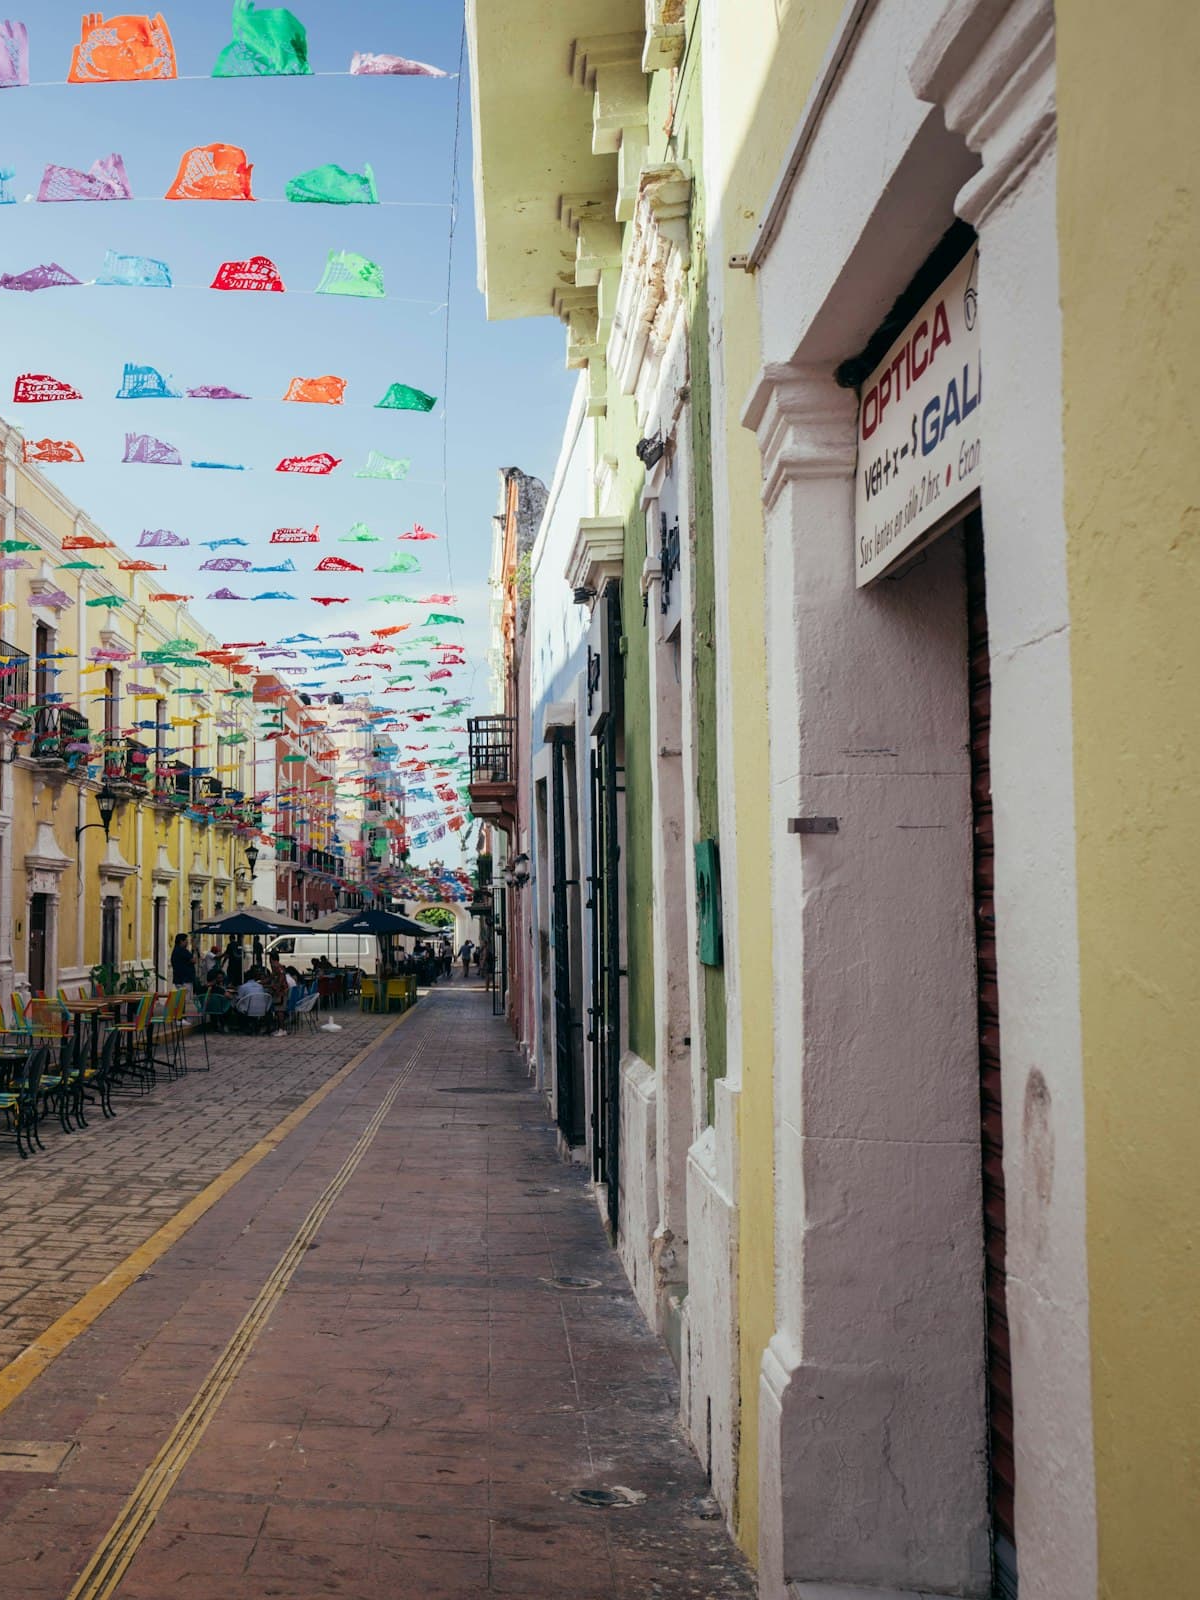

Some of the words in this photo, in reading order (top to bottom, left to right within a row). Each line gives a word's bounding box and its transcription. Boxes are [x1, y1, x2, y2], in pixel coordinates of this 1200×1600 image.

[862, 300, 952, 441] OPTICA
[922, 348, 982, 457] GAL
[860, 535, 873, 569] Sus
[874, 519, 894, 558] lentes
[894, 509, 903, 537] en
[919, 475, 926, 512] 2
